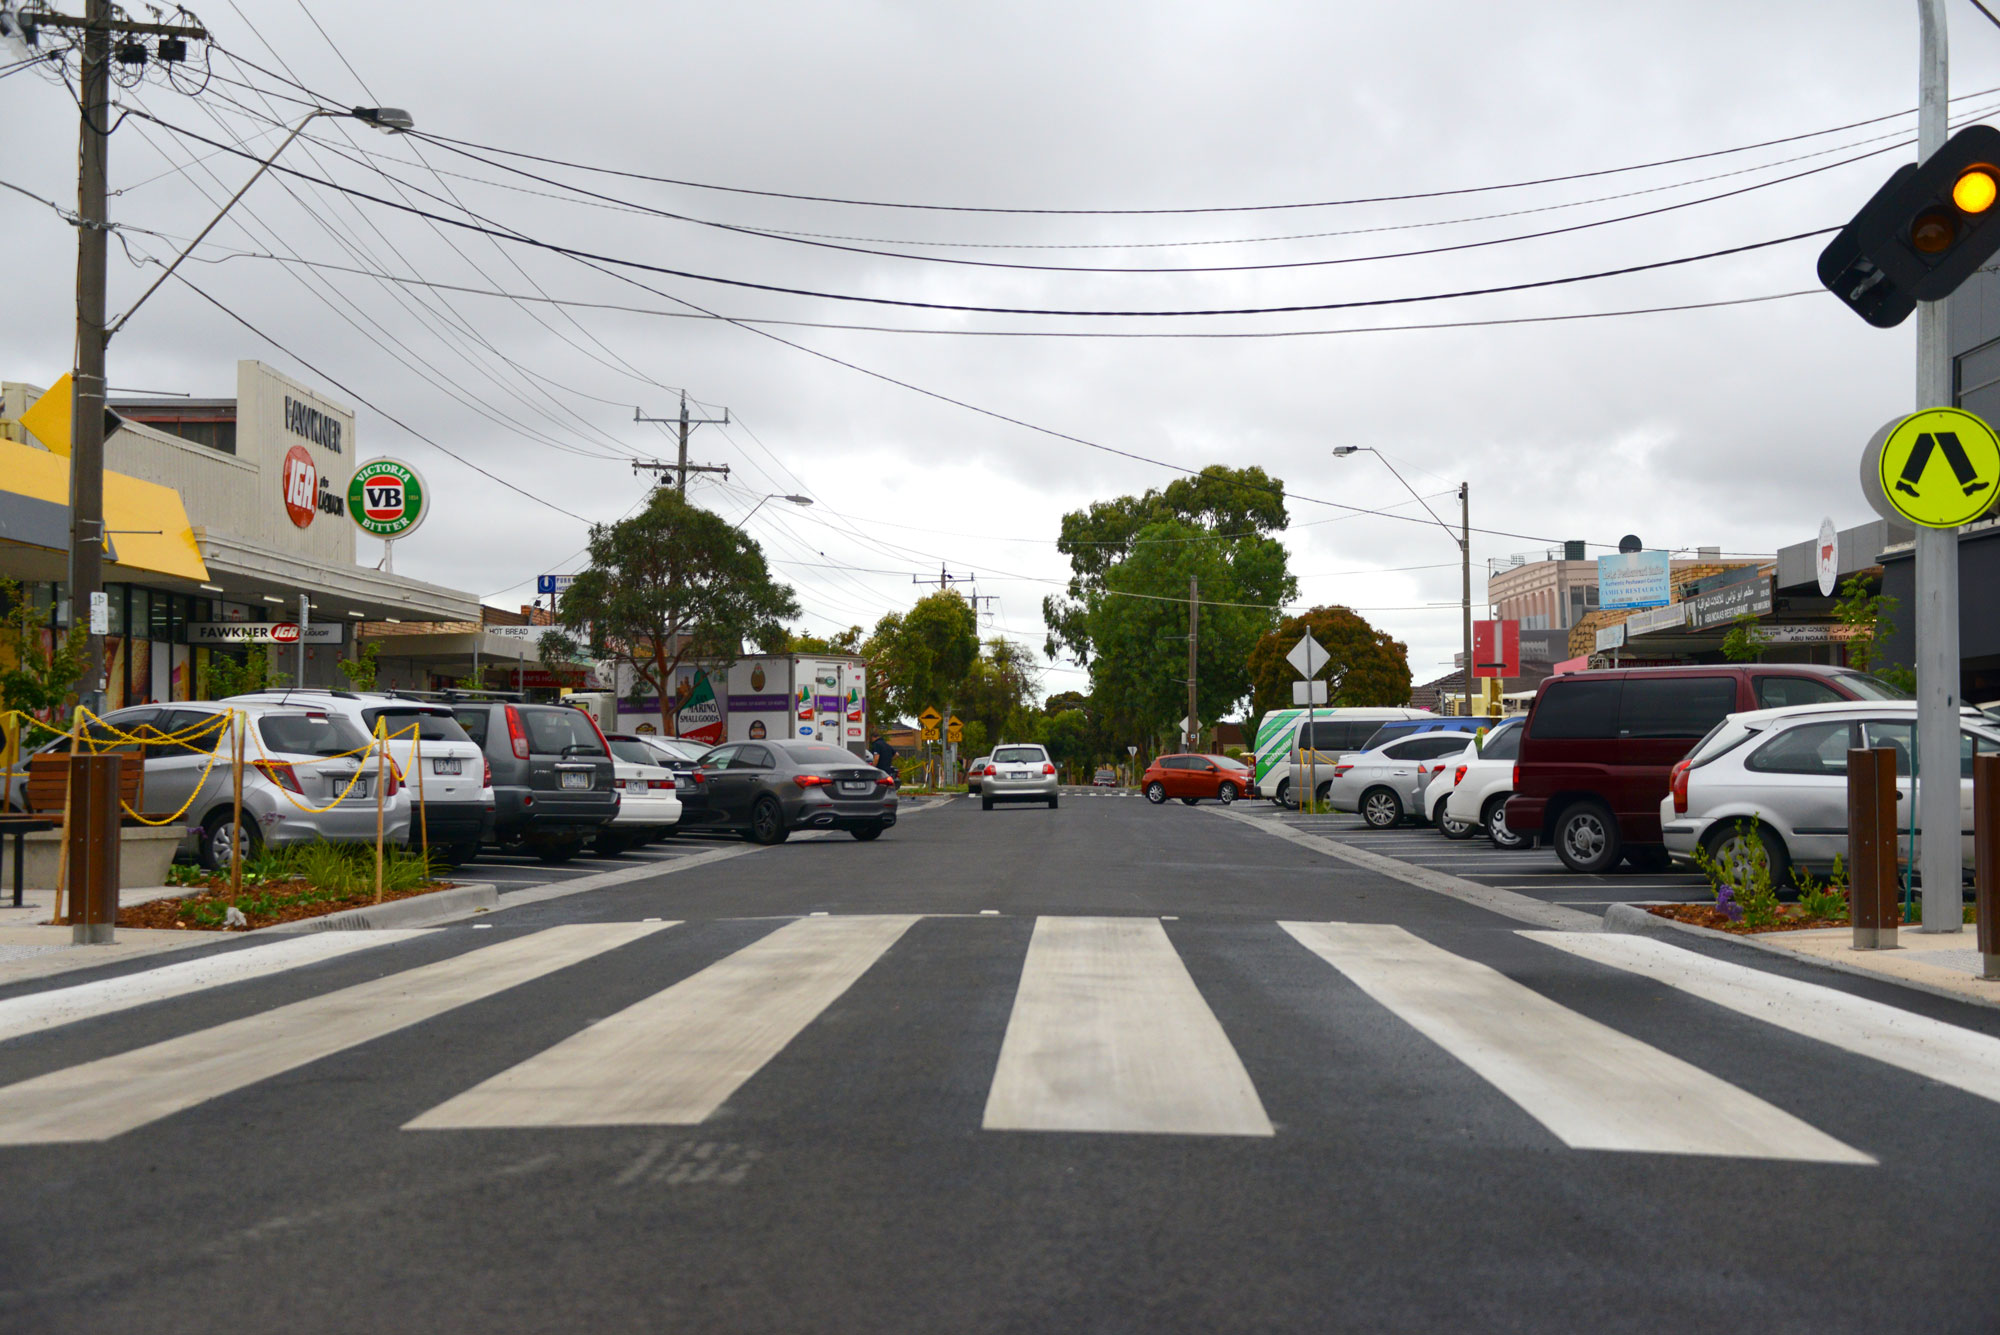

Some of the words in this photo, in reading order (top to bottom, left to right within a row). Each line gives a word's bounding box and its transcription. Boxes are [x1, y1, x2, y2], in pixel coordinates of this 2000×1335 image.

[285, 396, 342, 454] FAWKNER
[356, 464, 411, 482] VICTORIA
[287, 459, 314, 511] IGA
[318, 489, 344, 517] LIQUOR
[366, 488, 402, 508] VB
[362, 517, 411, 532] BITTER
[1625, 585, 1667, 594] RESTAURANT
[200, 627, 268, 638] FAWKNER
[274, 626, 299, 638] IGA
[688, 703, 717, 713] MARINO
[680, 714, 720, 722] SMALLGOODS
